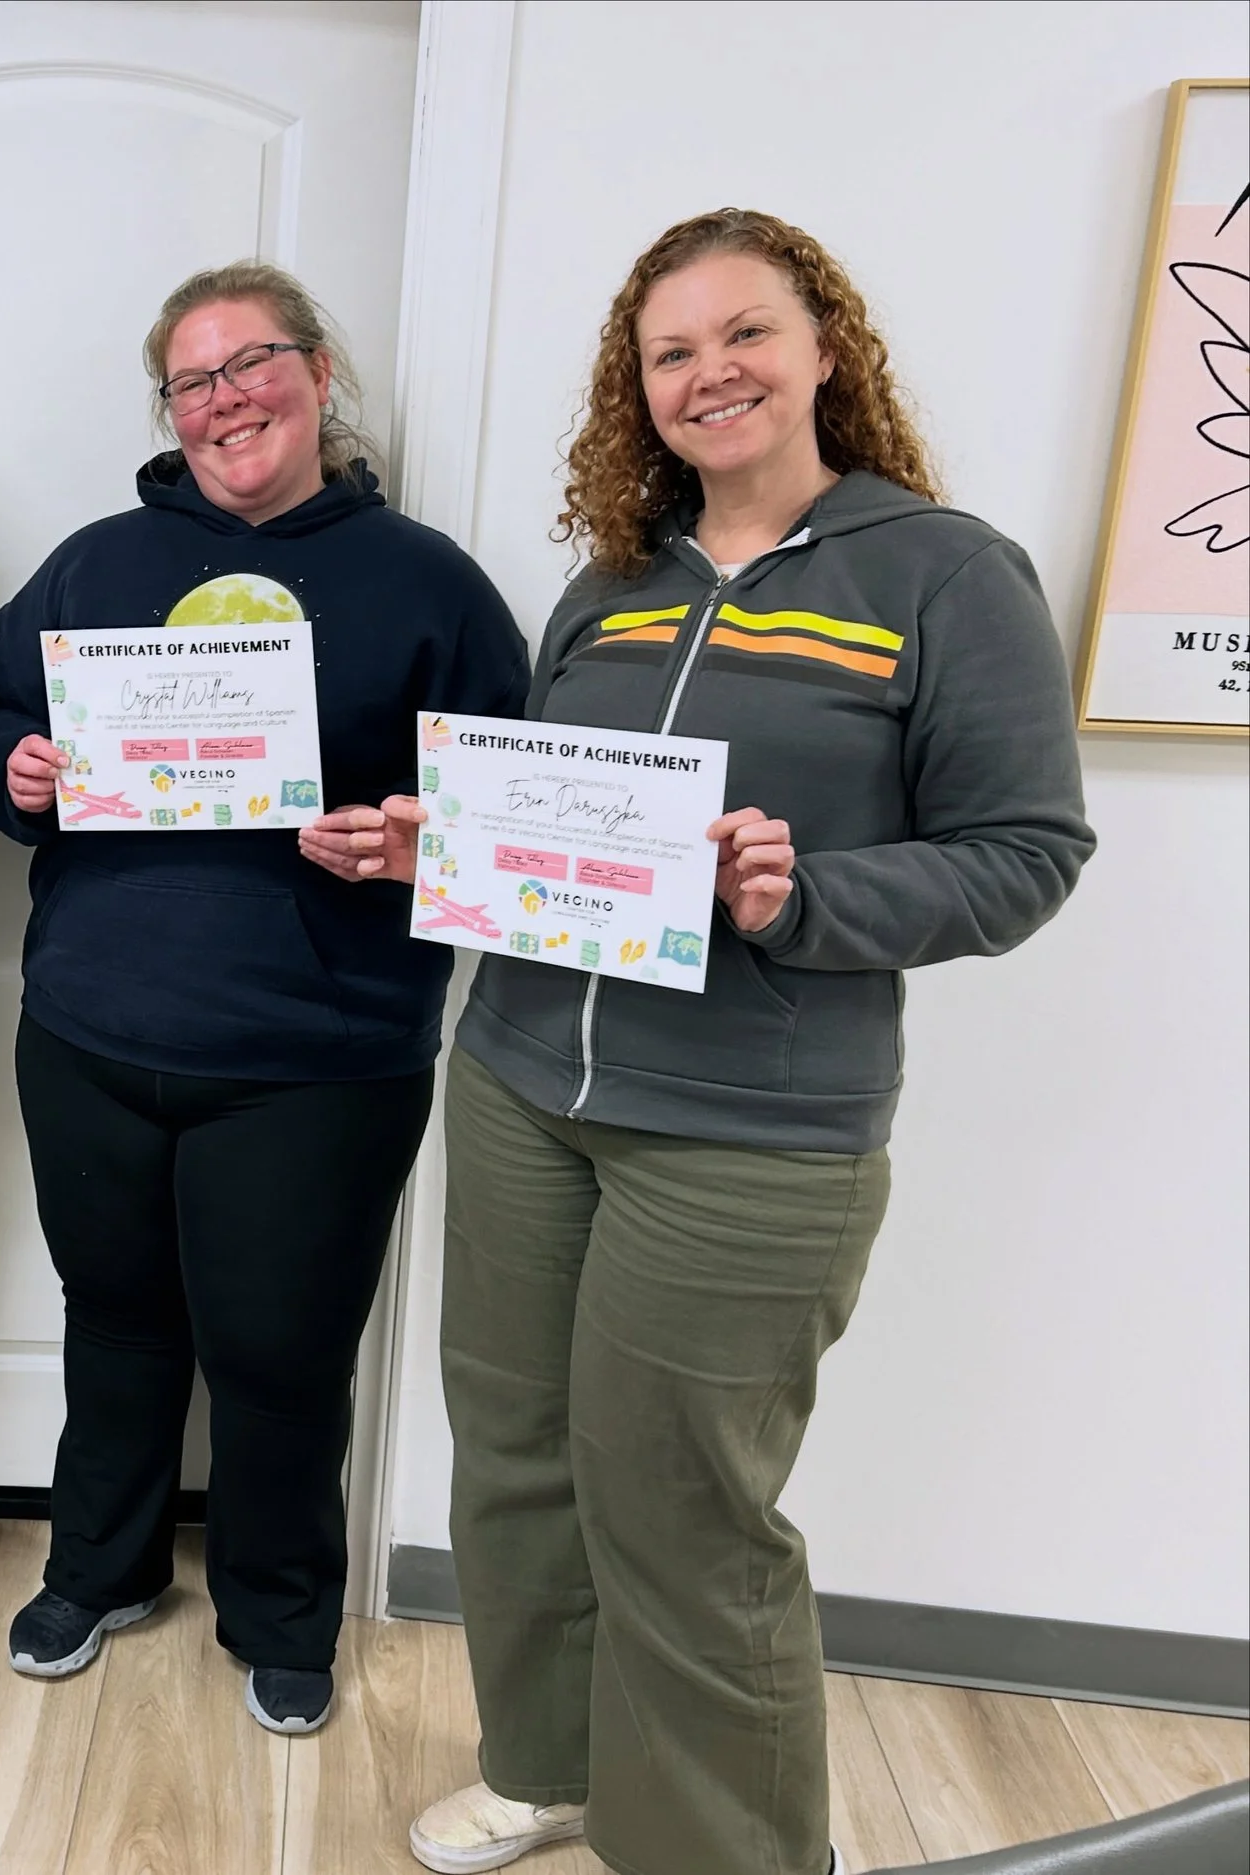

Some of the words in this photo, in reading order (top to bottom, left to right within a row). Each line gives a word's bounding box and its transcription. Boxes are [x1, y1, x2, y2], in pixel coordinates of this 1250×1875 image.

[79, 644, 163, 657] CERTIFICATE
[167, 643, 184, 655] OF
[189, 639, 291, 654] ACHIEVEMENT
[1218, 679, 1241, 692] 42,
[459, 733, 554, 755] CERTIFICATE
[559, 743, 579, 758] OF
[584, 746, 701, 773] ACHIEVEMENT
[179, 769, 235, 779] VECINO
[552, 891, 613, 911] VECINO
